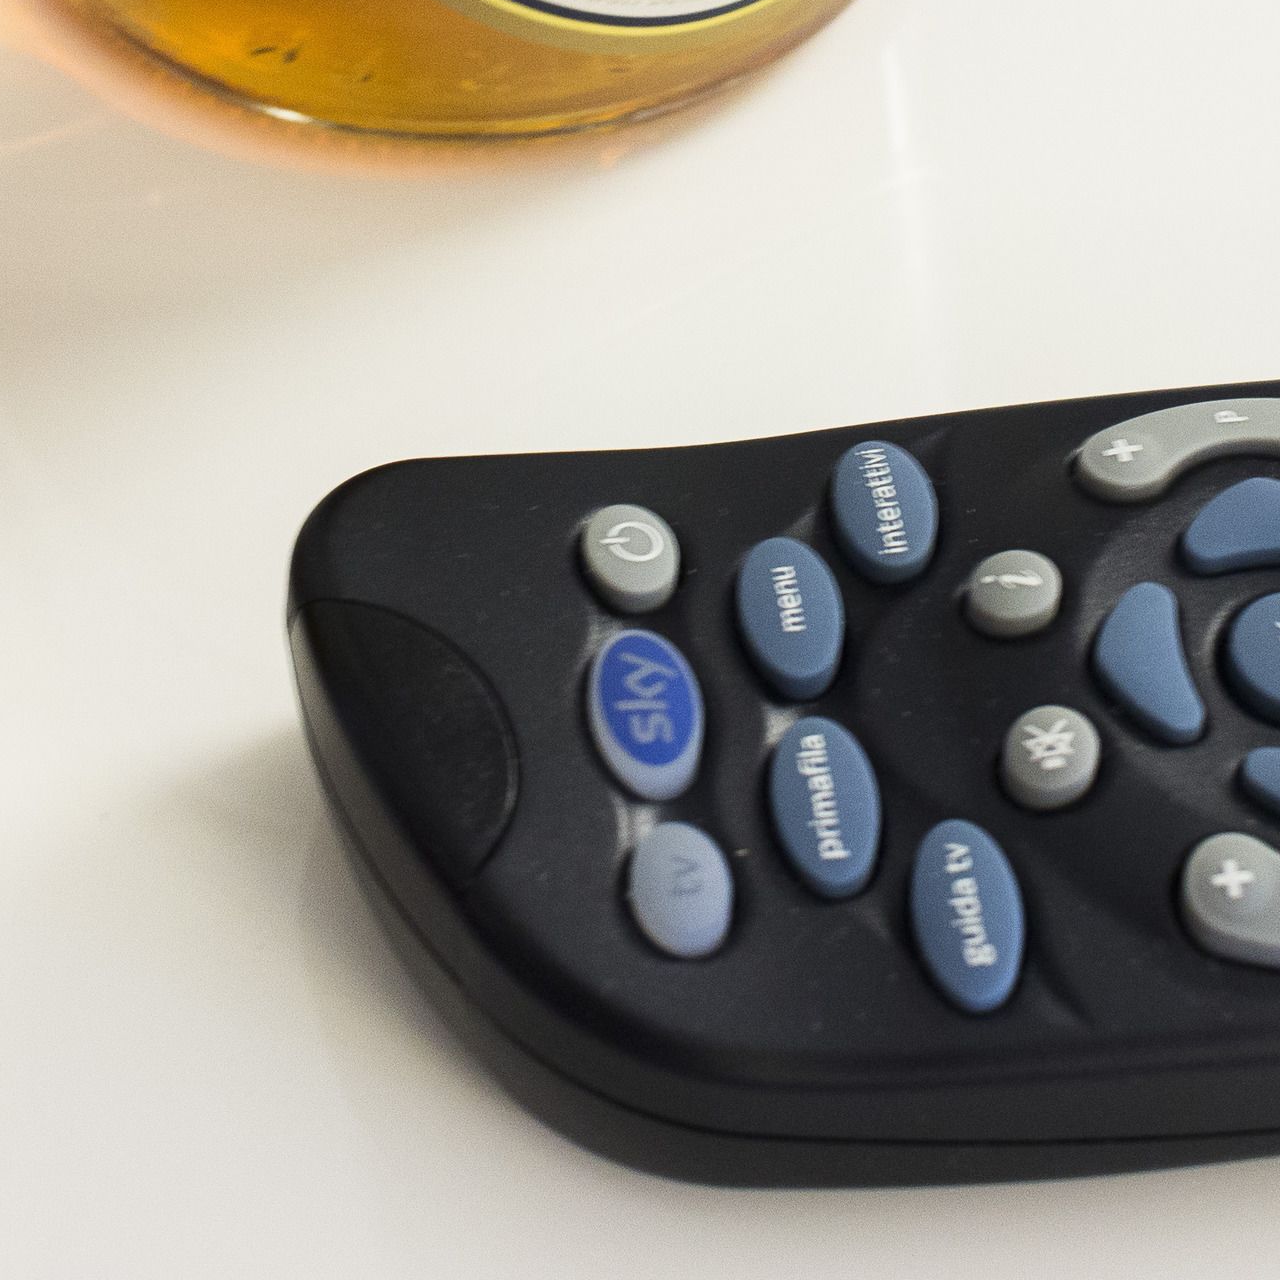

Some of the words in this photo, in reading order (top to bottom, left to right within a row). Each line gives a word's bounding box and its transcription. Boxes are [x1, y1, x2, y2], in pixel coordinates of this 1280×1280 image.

[854, 445, 912, 558] interattivi
[768, 563, 809, 635] menu
[615, 652, 680, 747] sky
[796, 732, 853, 862] primafila
[667, 853, 704, 900] tv
[942, 841, 976, 875] tv
[945, 875, 1000, 970] guida
